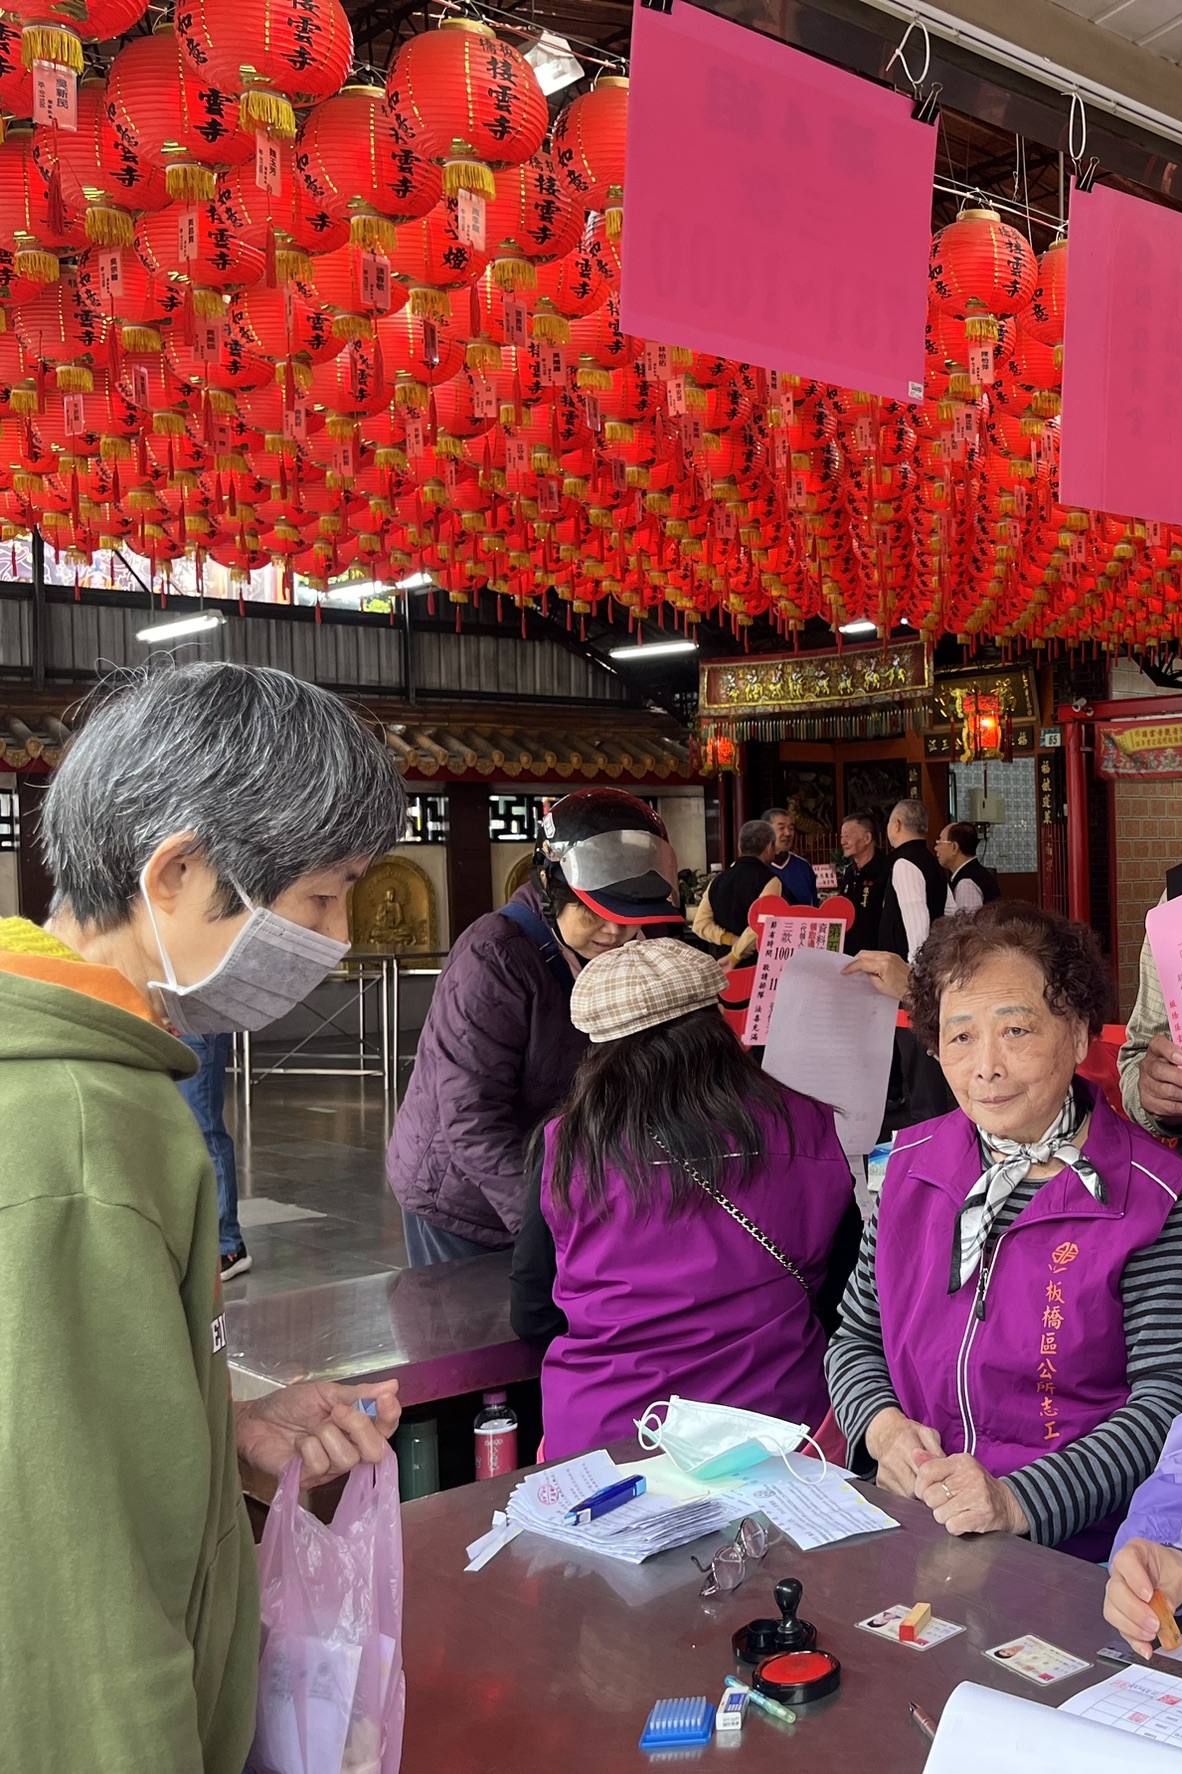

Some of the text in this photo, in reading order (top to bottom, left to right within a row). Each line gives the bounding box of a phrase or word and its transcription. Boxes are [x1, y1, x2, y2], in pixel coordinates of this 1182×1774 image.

[482, 57, 520, 141] 接雲寺
[527, 173, 563, 245] 接雲寺
[1000, 240, 1026, 298] 接雲寺
[1048, 735, 1058, 745] 65
[781, 922, 794, 944] 三款
[1036, 1279, 1066, 1440] 板橋區公所志工
